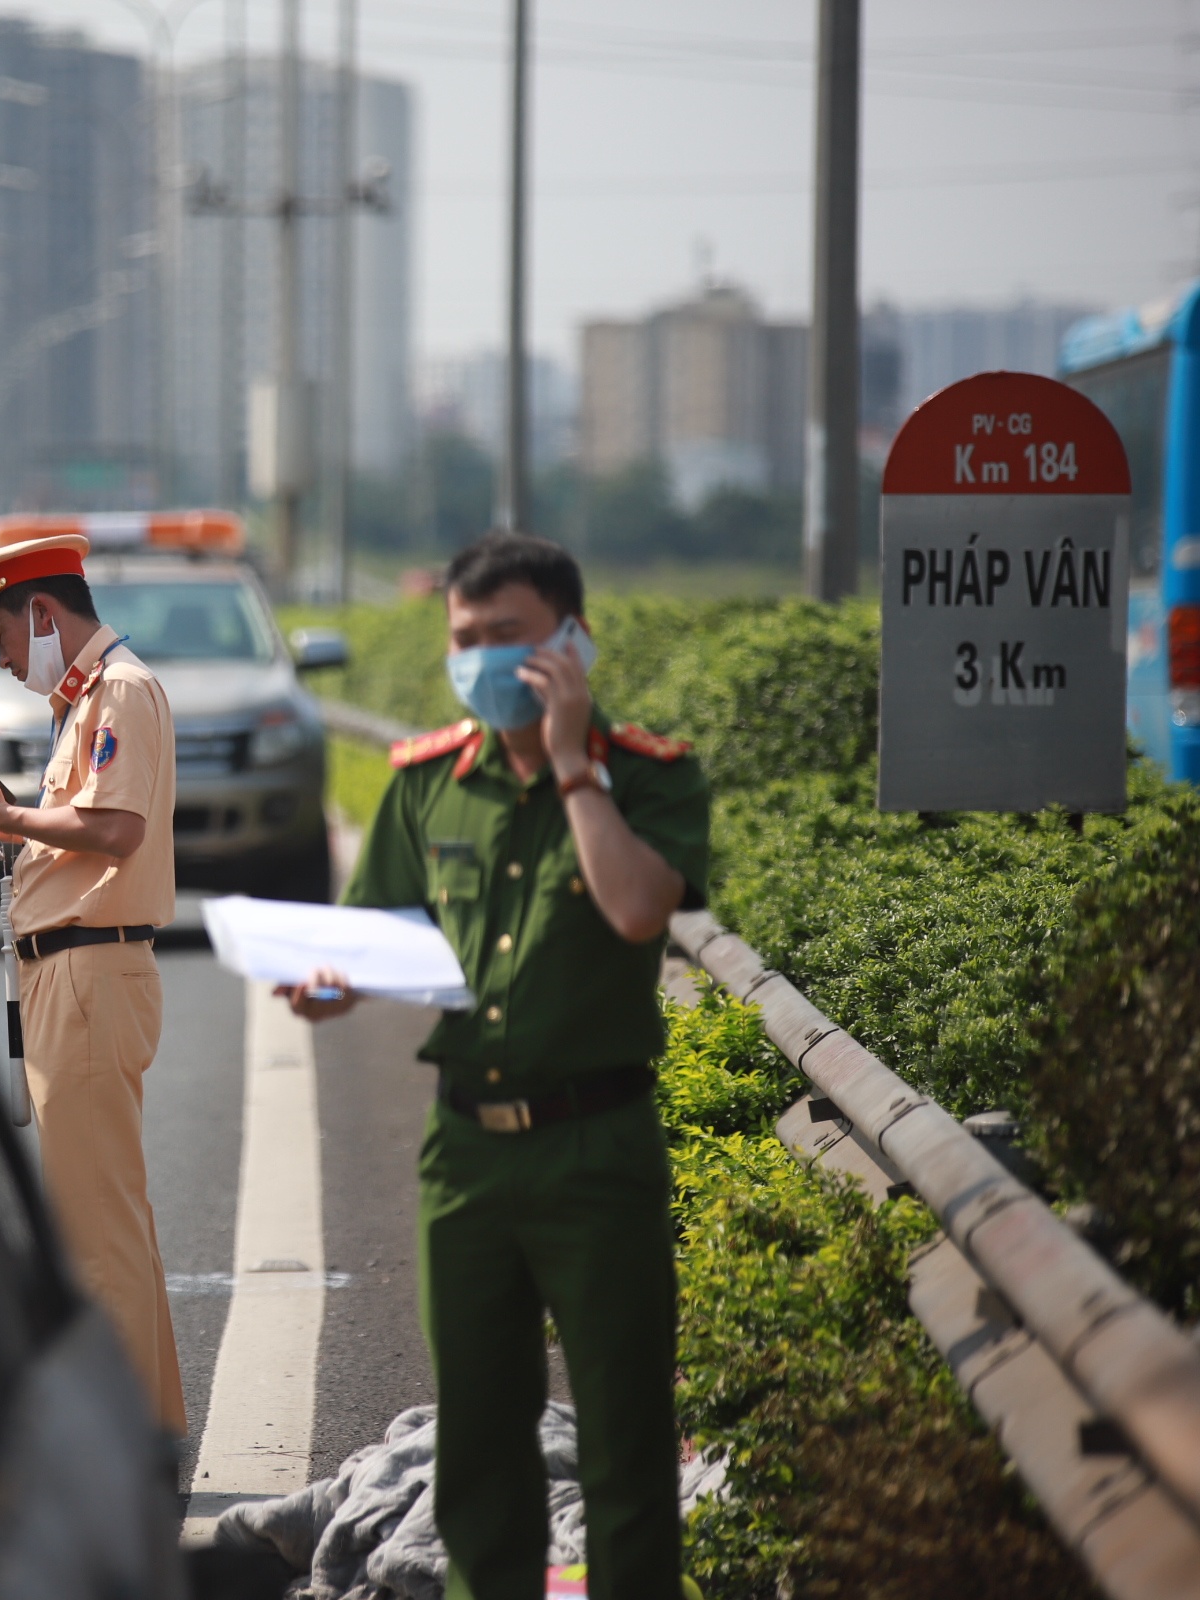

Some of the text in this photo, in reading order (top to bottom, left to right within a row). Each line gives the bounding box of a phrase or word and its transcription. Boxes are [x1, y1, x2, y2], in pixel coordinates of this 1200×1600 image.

[955, 441, 1078, 484] Km 184
[903, 532, 1110, 608] PHÁP VÂN
[955, 640, 1067, 691] 3 Km
